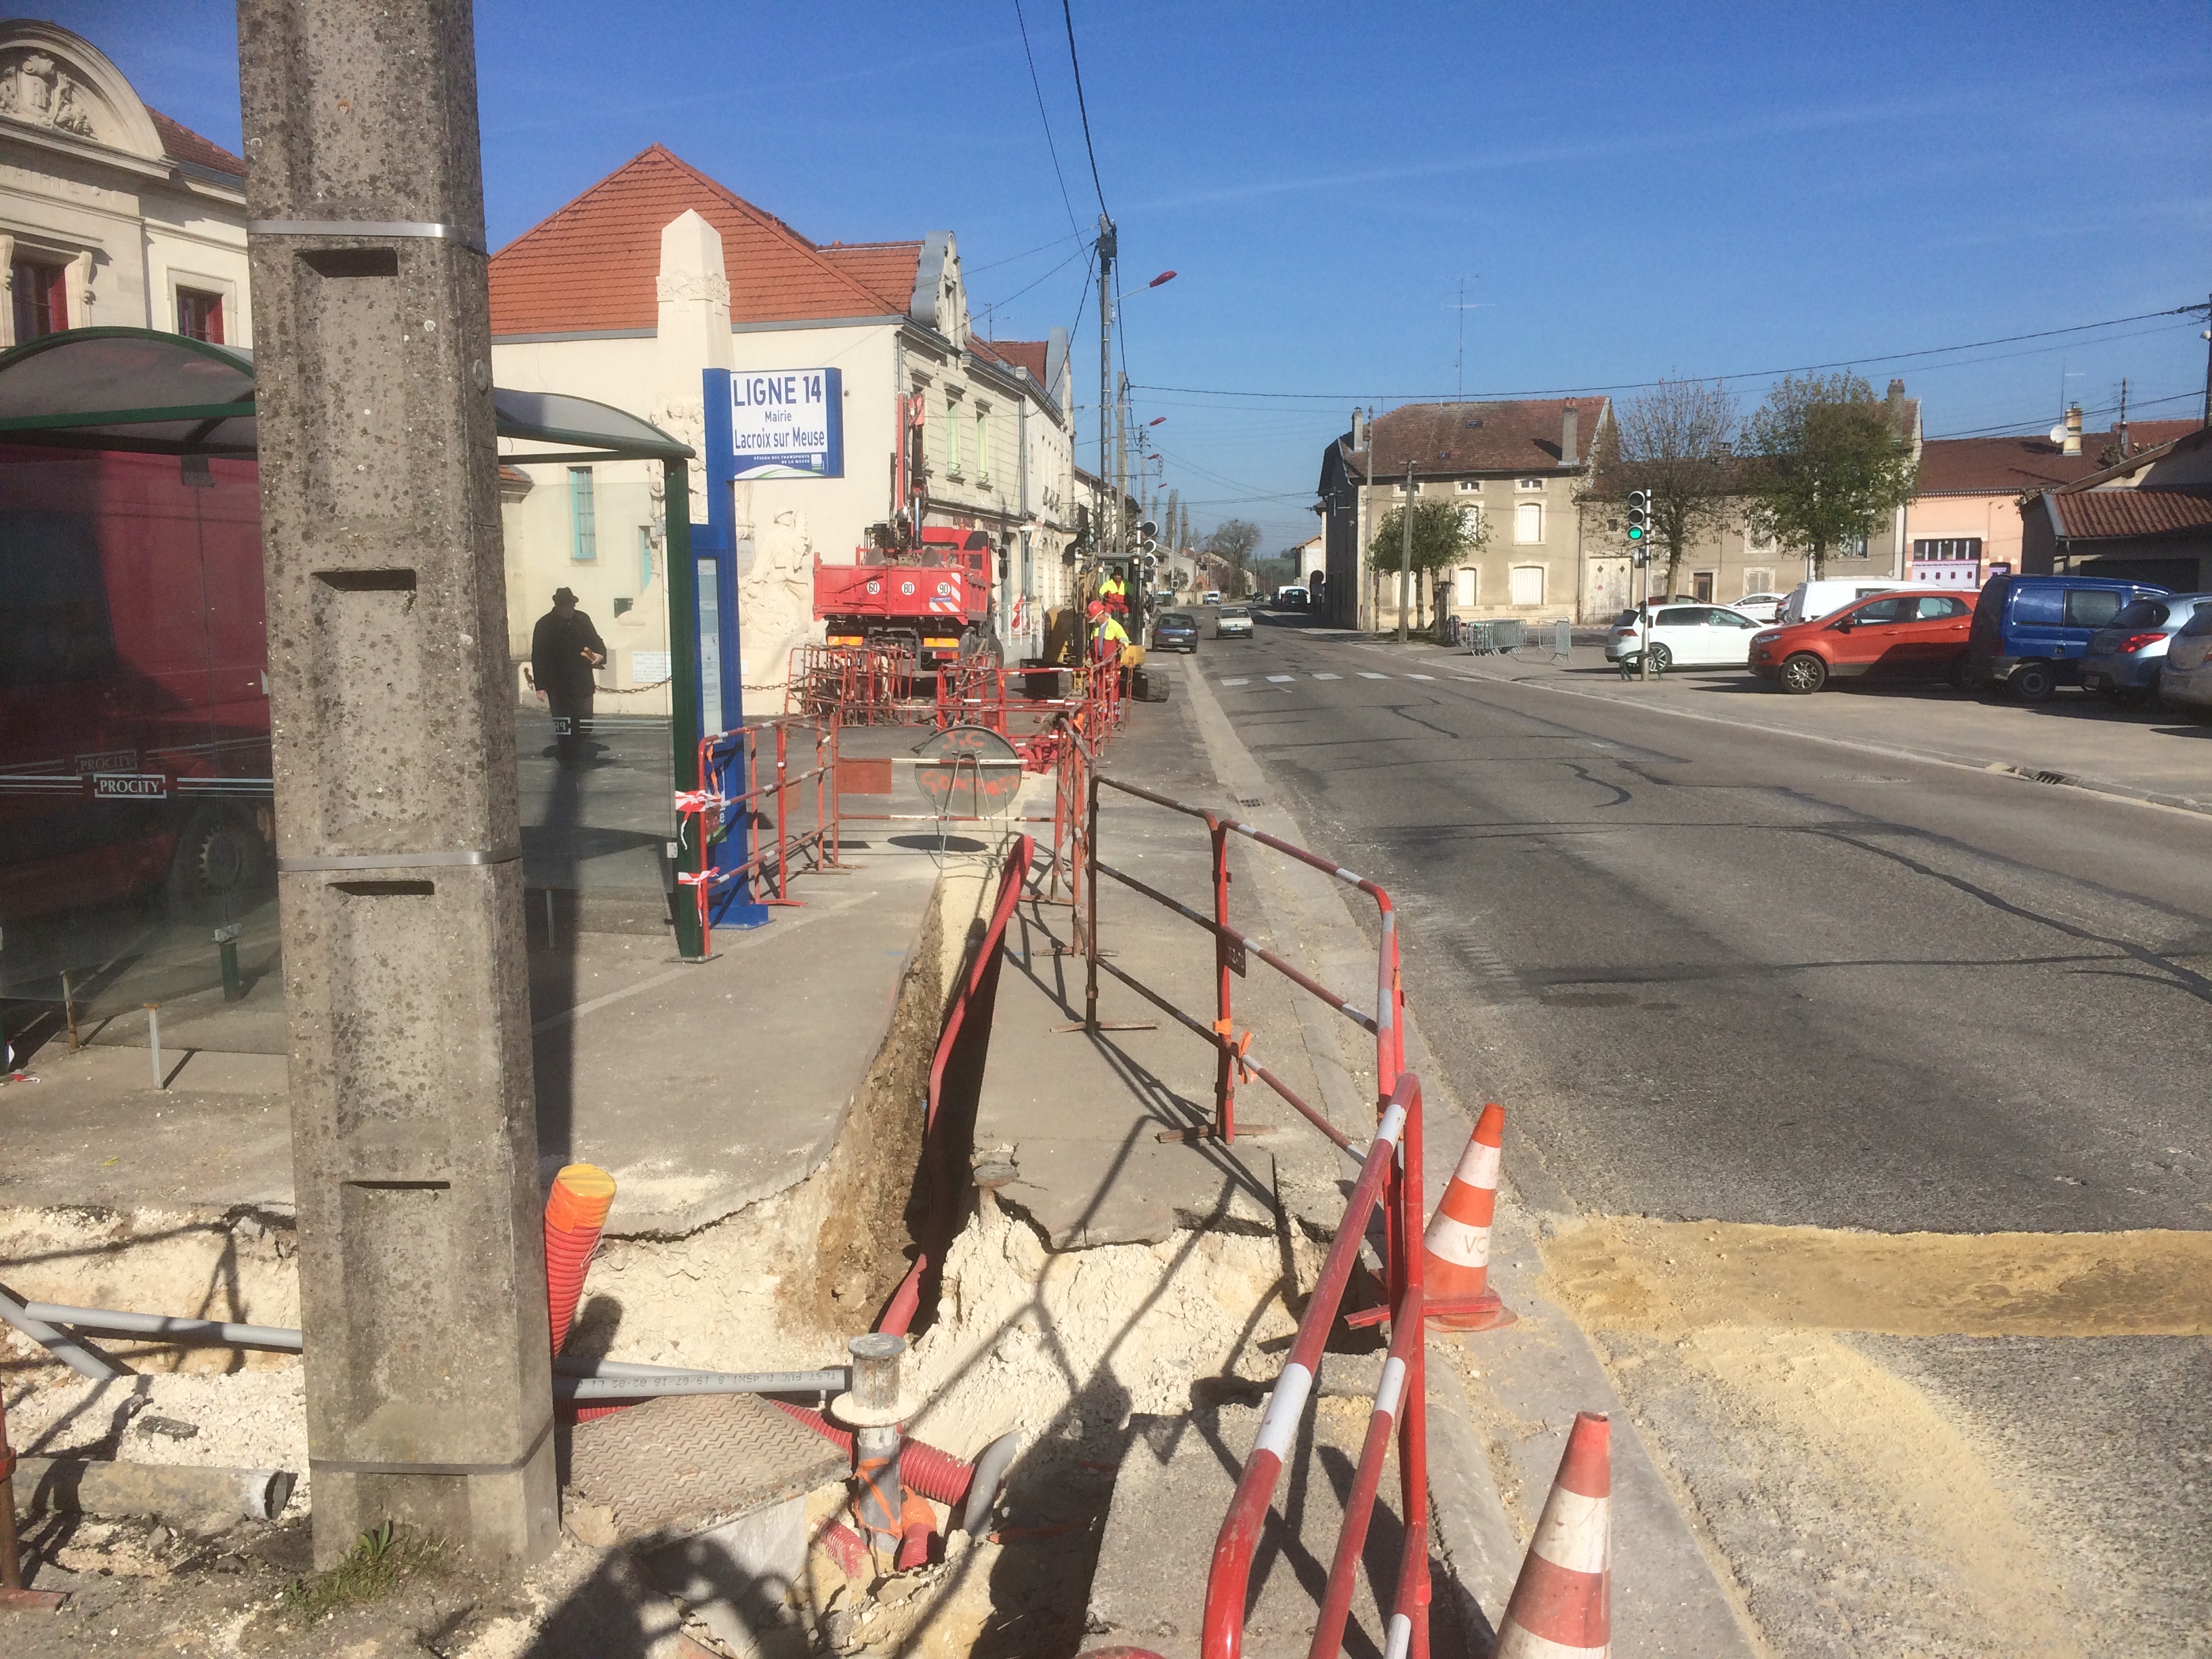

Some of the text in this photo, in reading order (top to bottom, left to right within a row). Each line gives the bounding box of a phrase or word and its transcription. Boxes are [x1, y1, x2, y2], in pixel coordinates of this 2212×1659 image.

[733, 375, 821, 407] LIGNE 14
[765, 410, 792, 422] Mairie
[735, 426, 825, 449] Lacroix sur Meuse
[869, 583, 878, 593] 60
[903, 583, 913, 594] 80
[939, 583, 948, 594] 90
[81, 755, 131, 771] PROCITY
[100, 780, 159, 793] PROCITY
